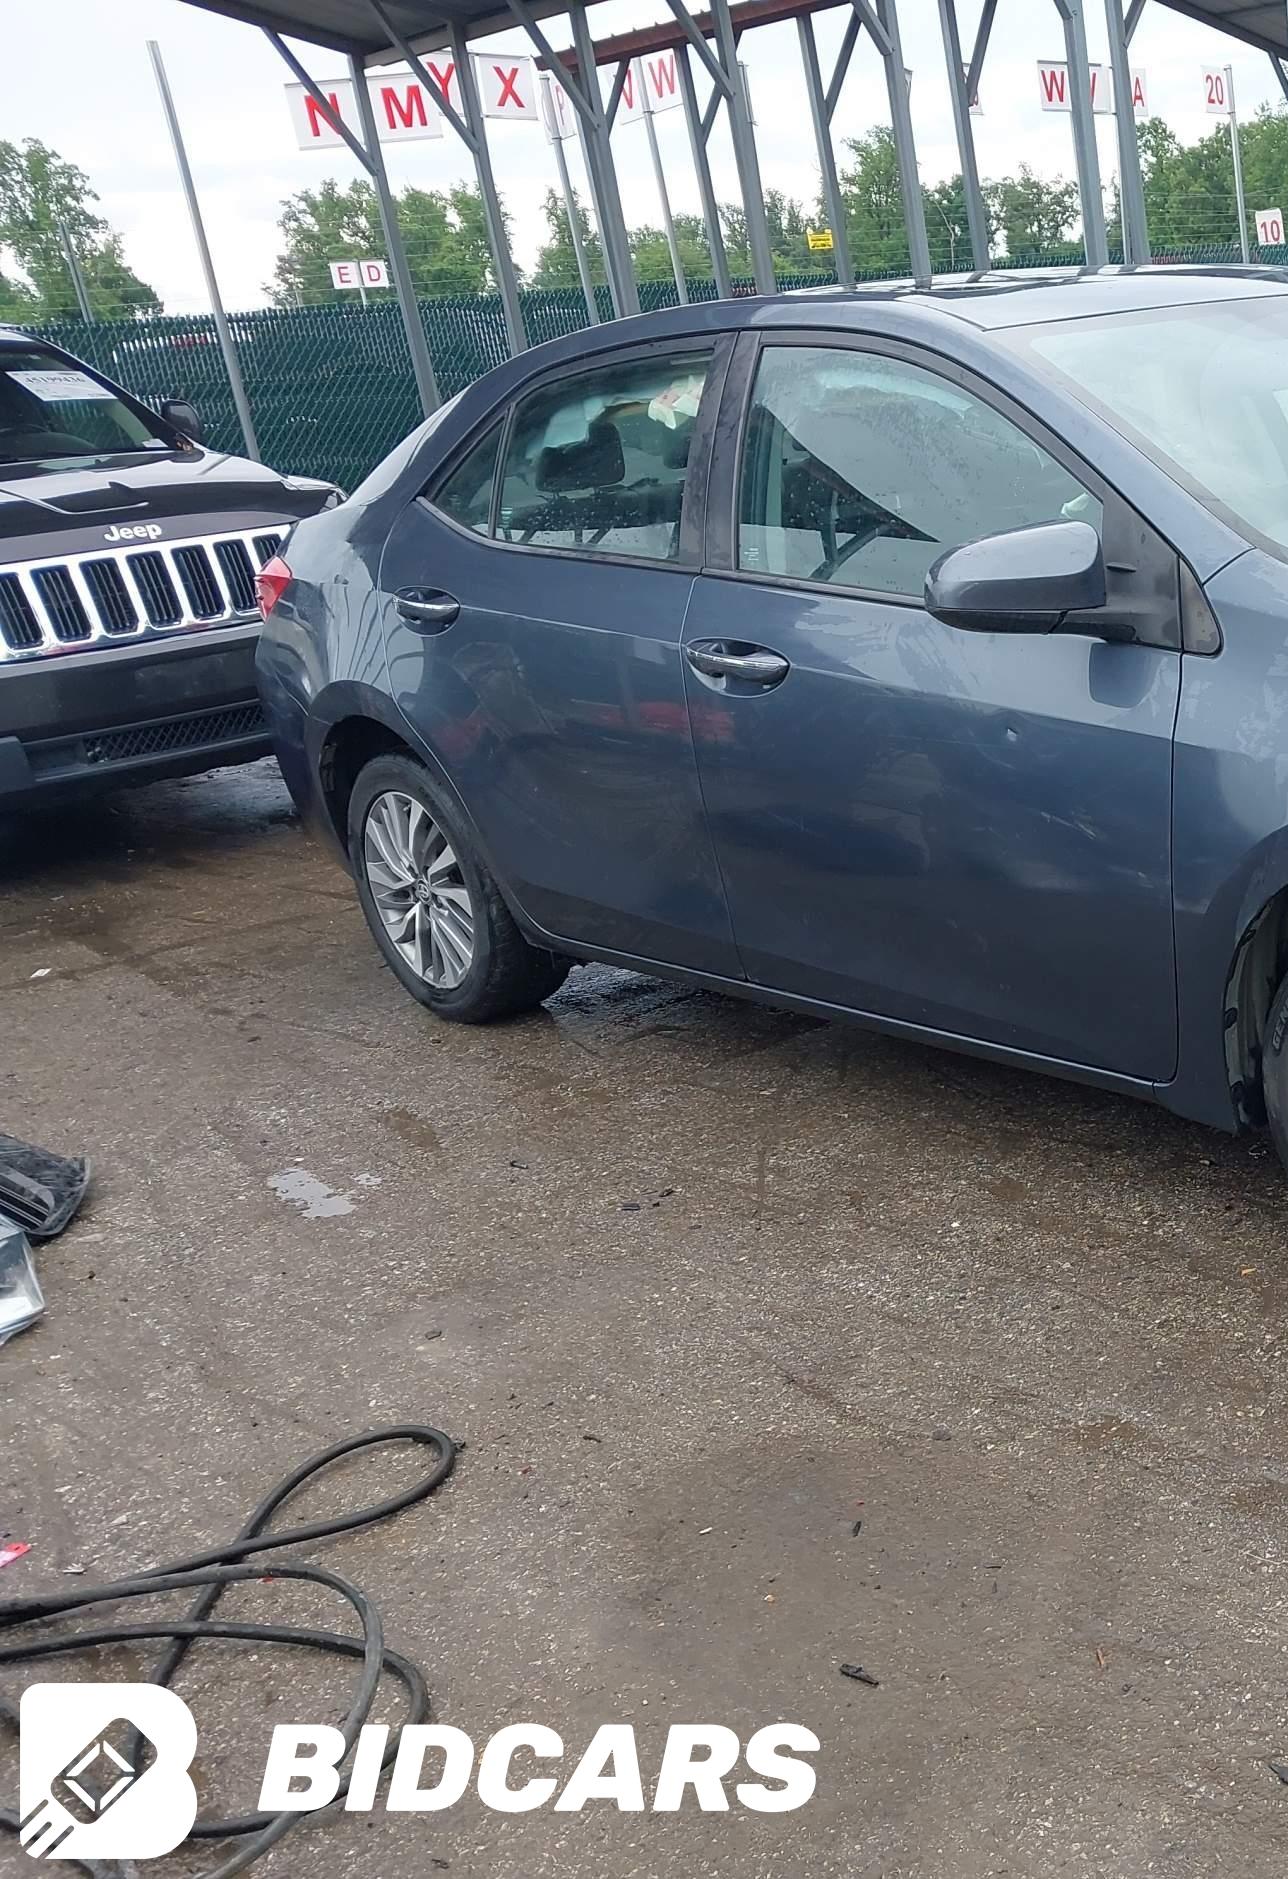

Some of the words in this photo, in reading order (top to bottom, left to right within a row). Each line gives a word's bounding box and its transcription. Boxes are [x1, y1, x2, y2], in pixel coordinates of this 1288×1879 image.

[426, 61, 455, 106] Y
[493, 65, 526, 108] X
[648, 55, 675, 98] W
[1040, 69, 1065, 103] W
[1132, 76, 1145, 107] A
[1205, 74, 1224, 105] 20
[304, 93, 342, 136] N
[380, 85, 428, 129] M
[1260, 220, 1281, 245] 10
[339, 266, 352, 284] E
[368, 264, 381, 282] D
[104, 523, 162, 541] Jeep
